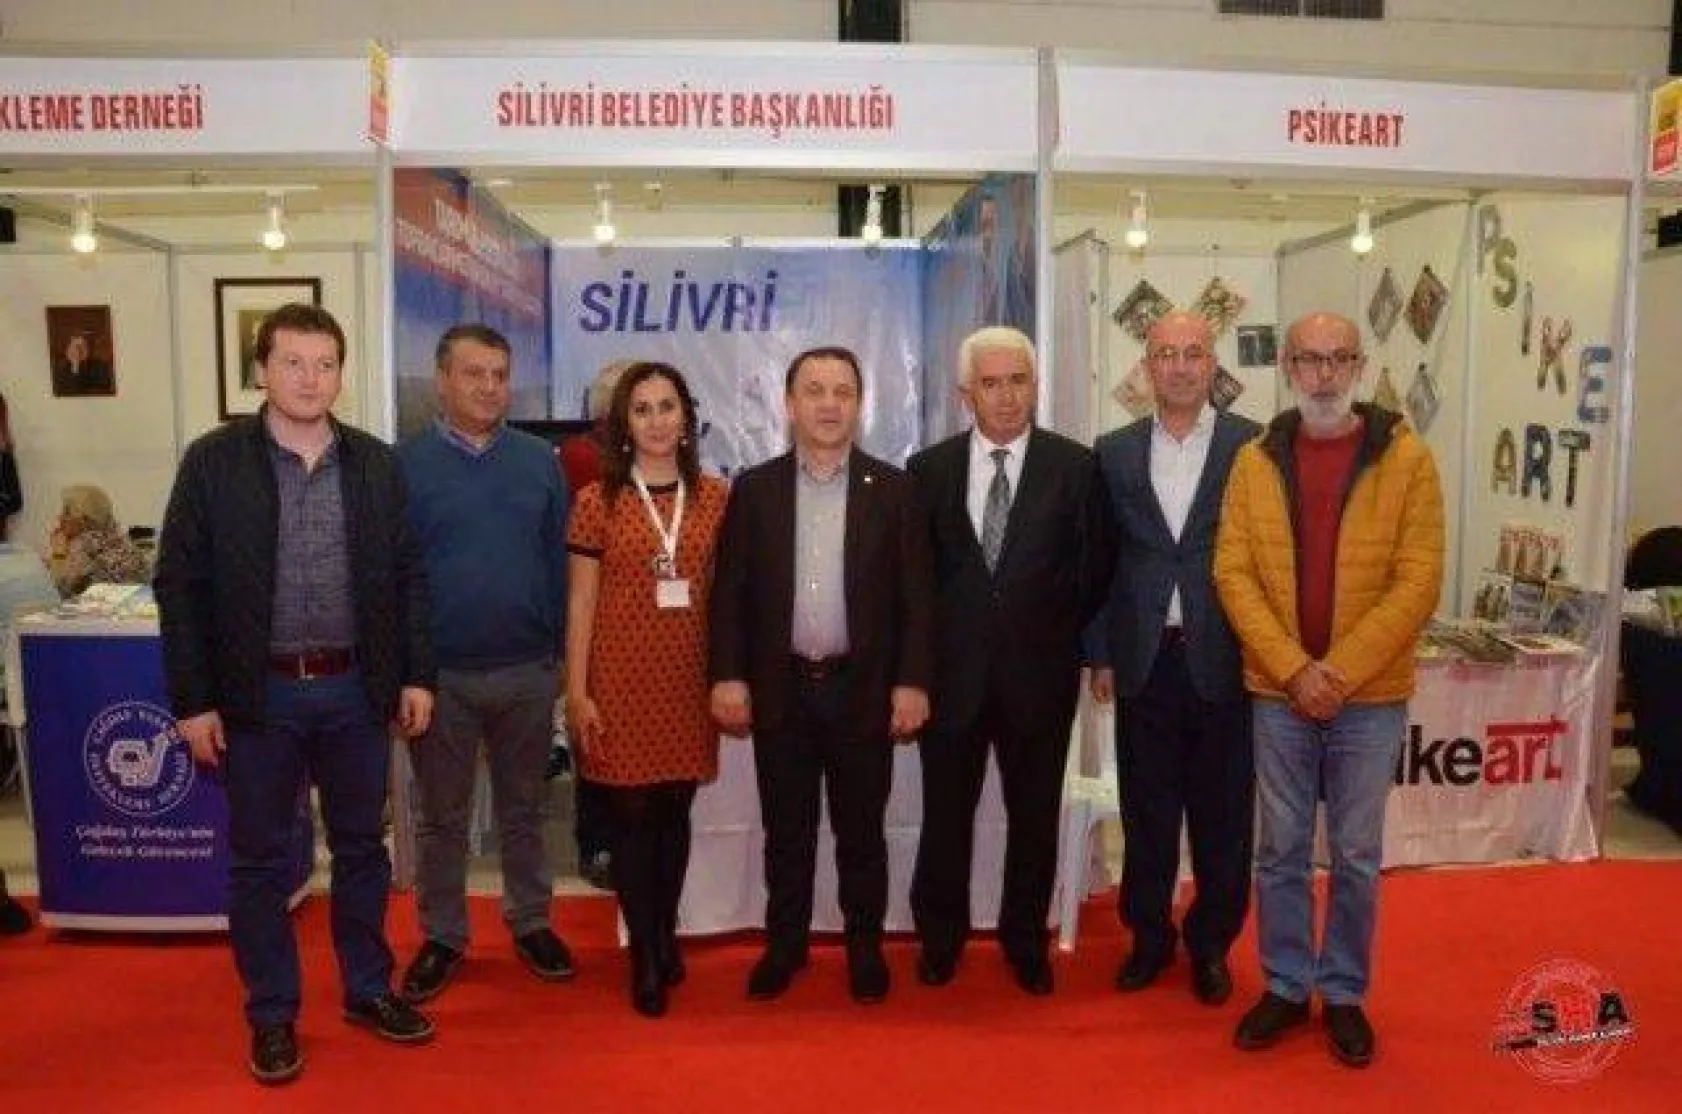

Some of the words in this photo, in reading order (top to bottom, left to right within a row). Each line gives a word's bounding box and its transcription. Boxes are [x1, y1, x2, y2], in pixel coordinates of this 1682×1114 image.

[91, 84, 204, 130] DERNEĞİ
[498, 81, 595, 127] SİLİVRİ
[601, 81, 724, 127] BELEDİYE
[731, 84, 893, 139] BAŞKANLIĞI
[1288, 100, 1404, 147] PSİKEART
[580, 270, 778, 332] SİLİVRİ
[1492, 423, 1592, 507] ART
